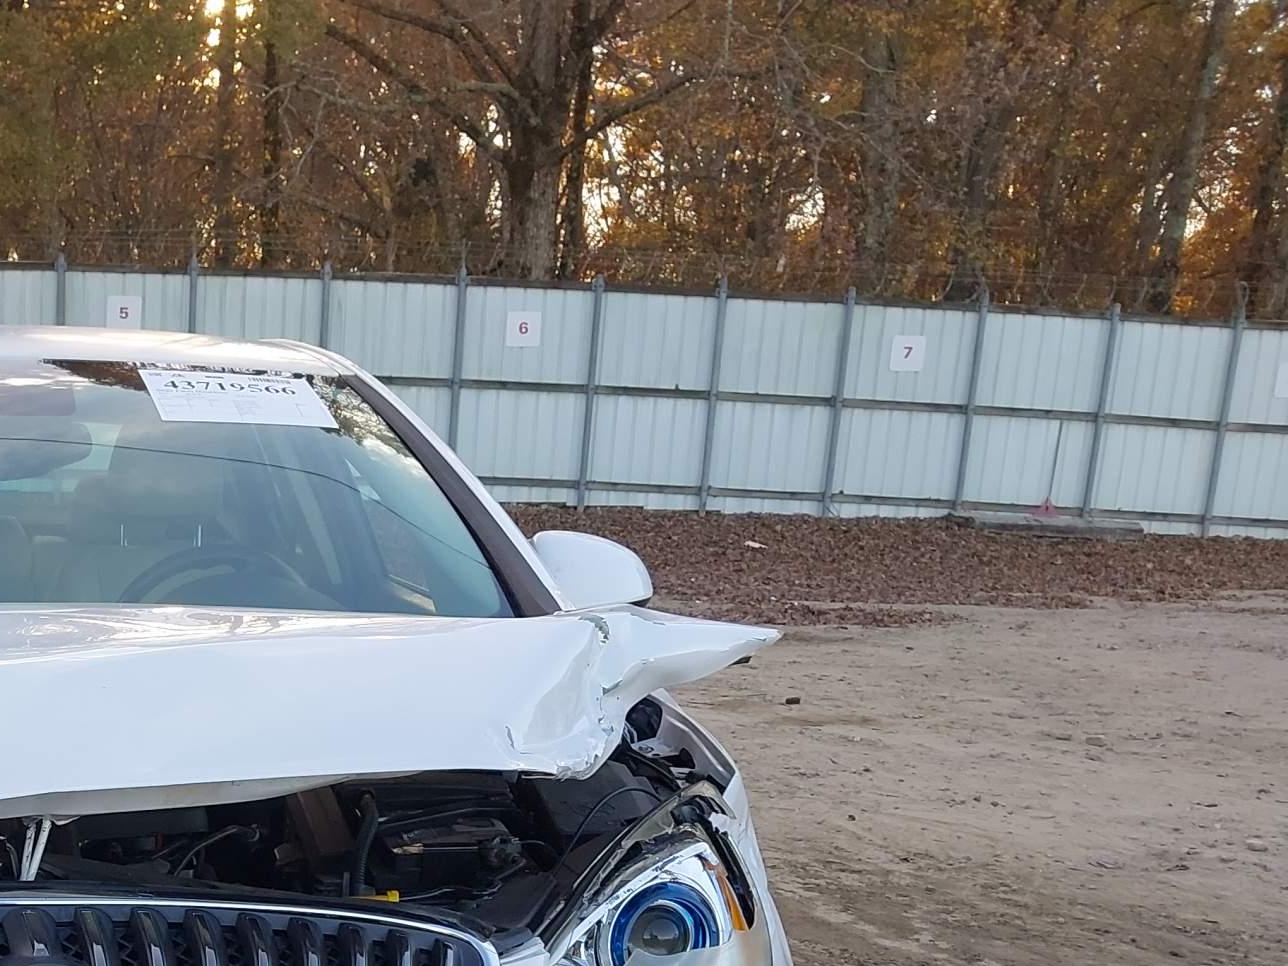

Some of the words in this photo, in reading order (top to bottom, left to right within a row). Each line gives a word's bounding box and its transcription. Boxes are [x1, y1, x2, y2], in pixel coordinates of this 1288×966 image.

[119, 307, 129, 319] 5
[518, 321, 529, 335] 6
[903, 346, 913, 359] 7
[163, 380, 297, 395] 43719566
